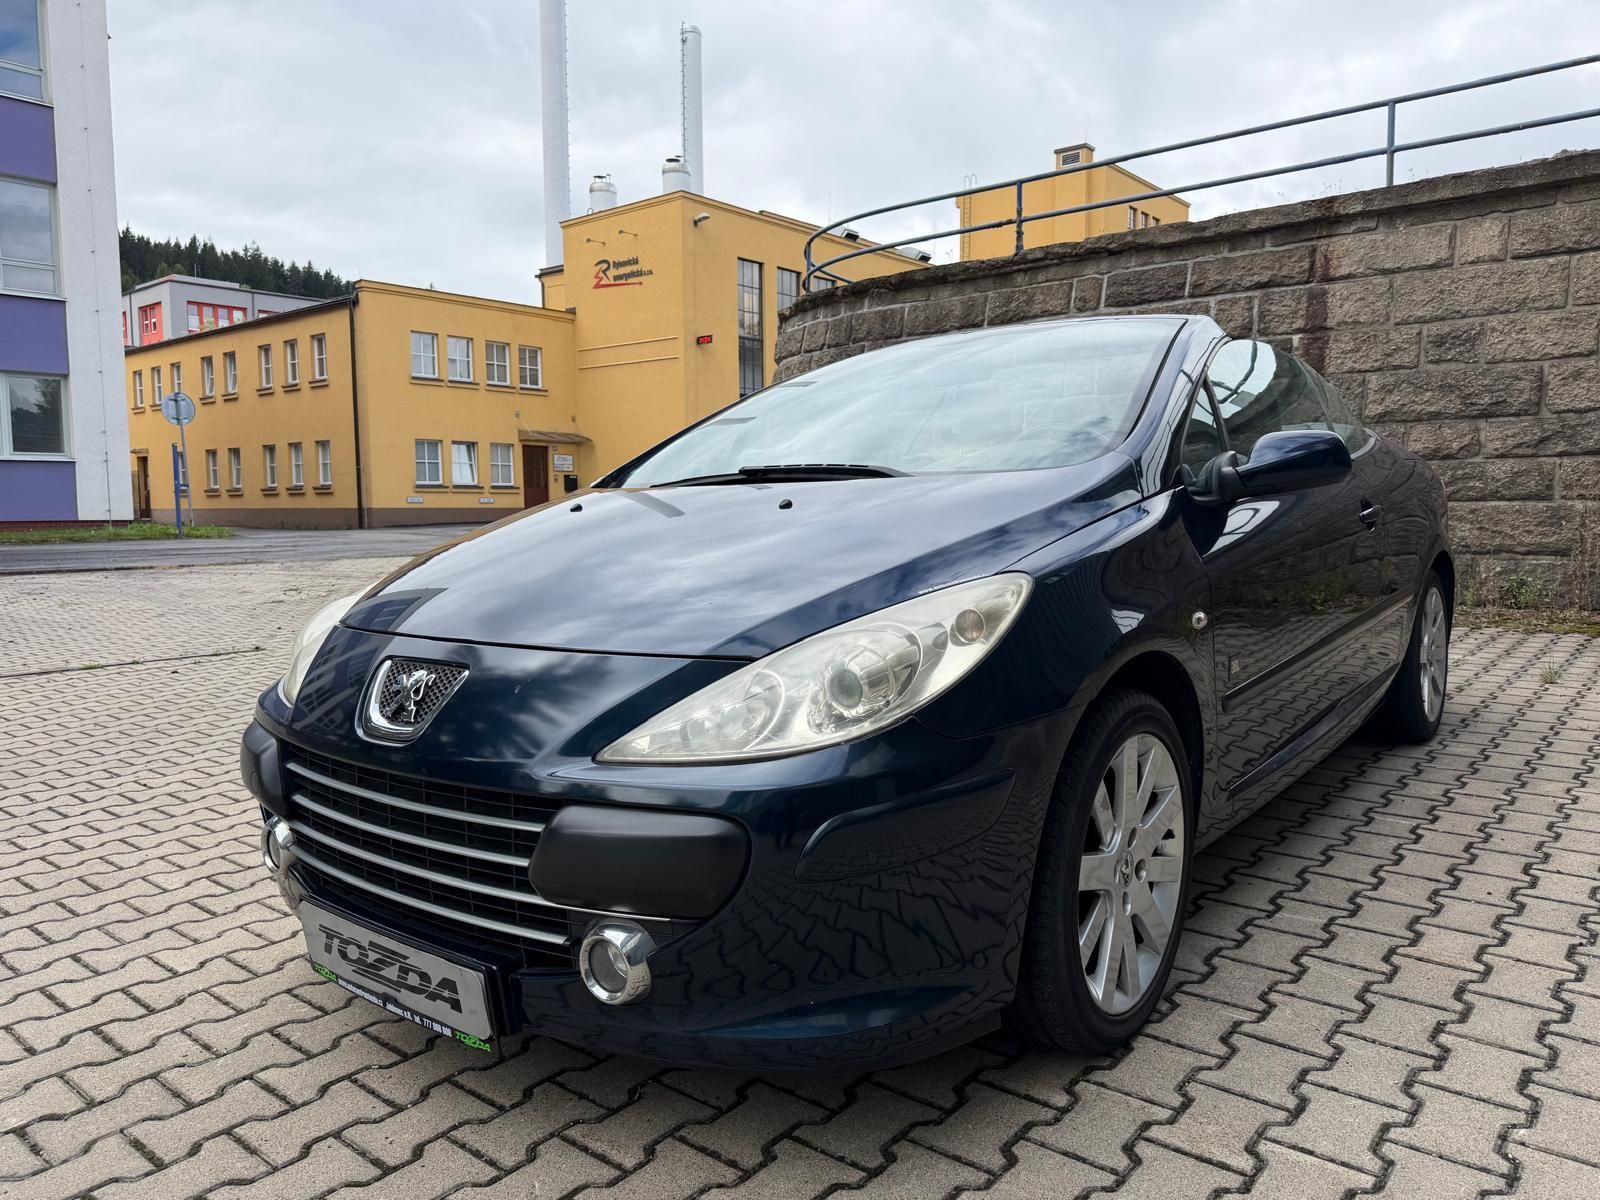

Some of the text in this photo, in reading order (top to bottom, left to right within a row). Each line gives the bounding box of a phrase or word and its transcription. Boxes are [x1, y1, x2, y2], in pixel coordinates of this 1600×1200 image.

[315, 963, 337, 982] TOZDA
[319, 924, 463, 1014] TOZDA
[422, 1017, 432, 1029] 777
[455, 1030, 491, 1053] TOZDA
